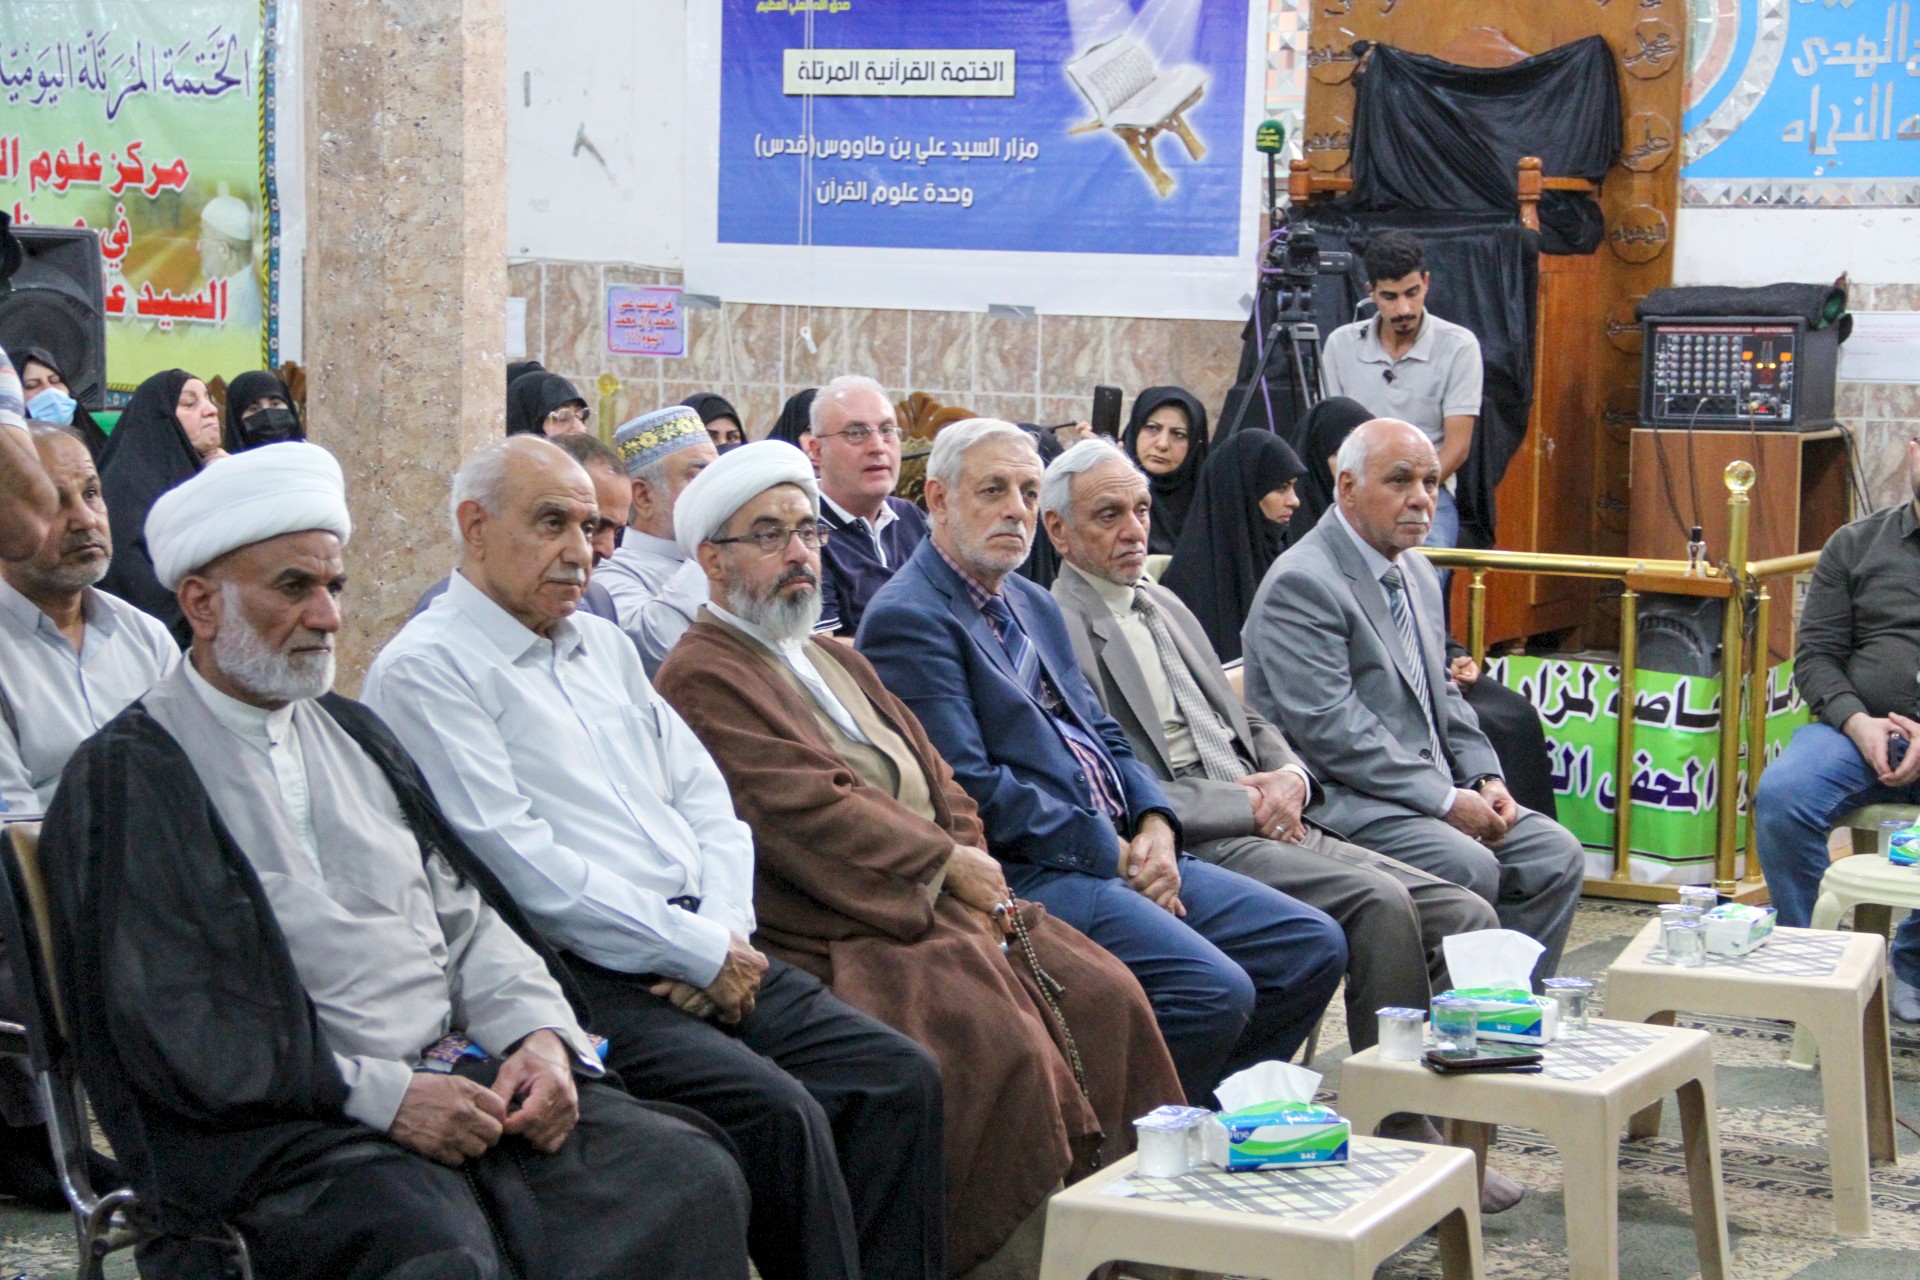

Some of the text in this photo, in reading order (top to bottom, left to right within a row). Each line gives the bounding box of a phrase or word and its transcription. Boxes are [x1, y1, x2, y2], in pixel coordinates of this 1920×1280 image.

[798, 58, 1003, 86] الختمة القرآنية المرتلة
[889, 136, 911, 163] بن
[916, 136, 947, 164] علي
[951, 136, 1000, 161] السيد
[1003, 136, 1039, 162] مزار
[30, 141, 103, 193] علوم
[109, 141, 189, 197] مركز
[815, 176, 974, 208] وحدة علوم القرآن
[101, 206, 129, 268] في
[137, 279, 227, 327] السيد
[1607, 664, 1721, 728] اصة
